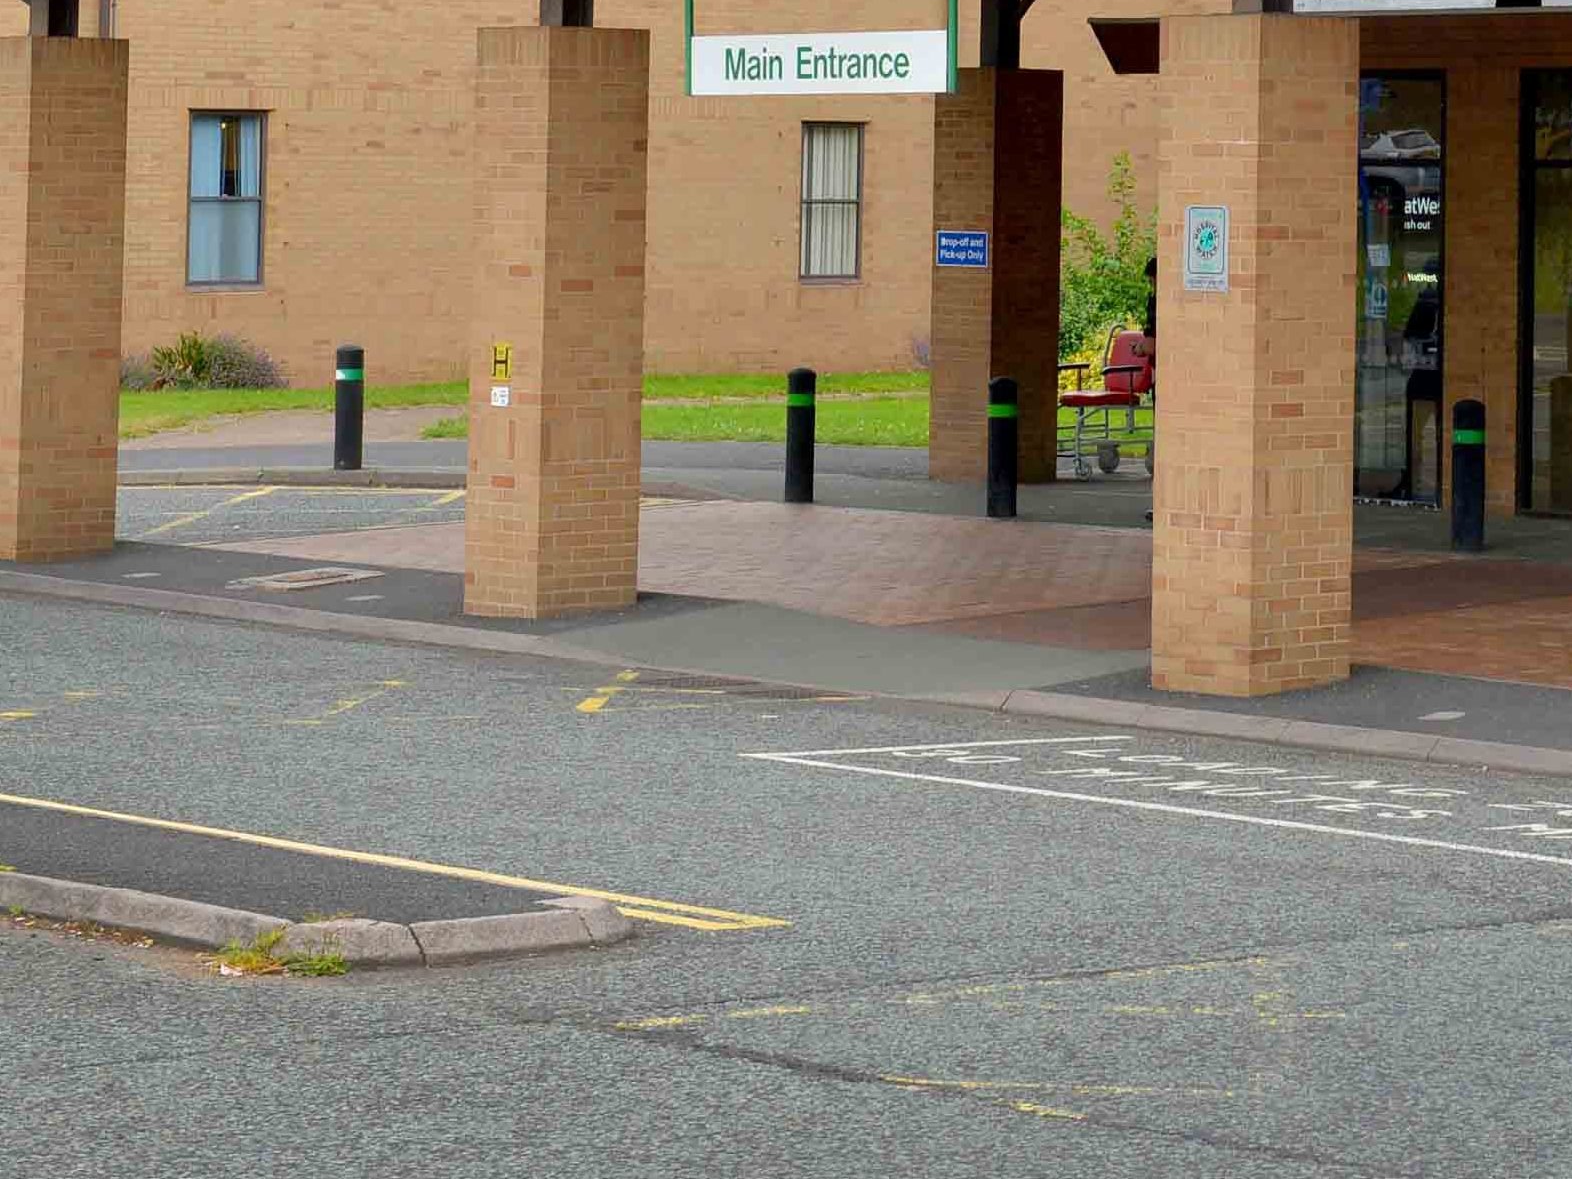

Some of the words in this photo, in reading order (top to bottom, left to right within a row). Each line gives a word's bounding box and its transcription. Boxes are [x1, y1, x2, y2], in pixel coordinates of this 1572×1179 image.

[724, 41, 783, 81] Main
[796, 45, 910, 80] Entrance
[940, 237, 969, 248] Drop-off
[969, 237, 984, 248] and
[940, 249, 966, 262] Pick-up
[967, 250, 984, 262] Only
[892, 749, 1022, 764] 30
[1034, 767, 1453, 819] MINUTES
[1062, 747, 1472, 797] LOADING
